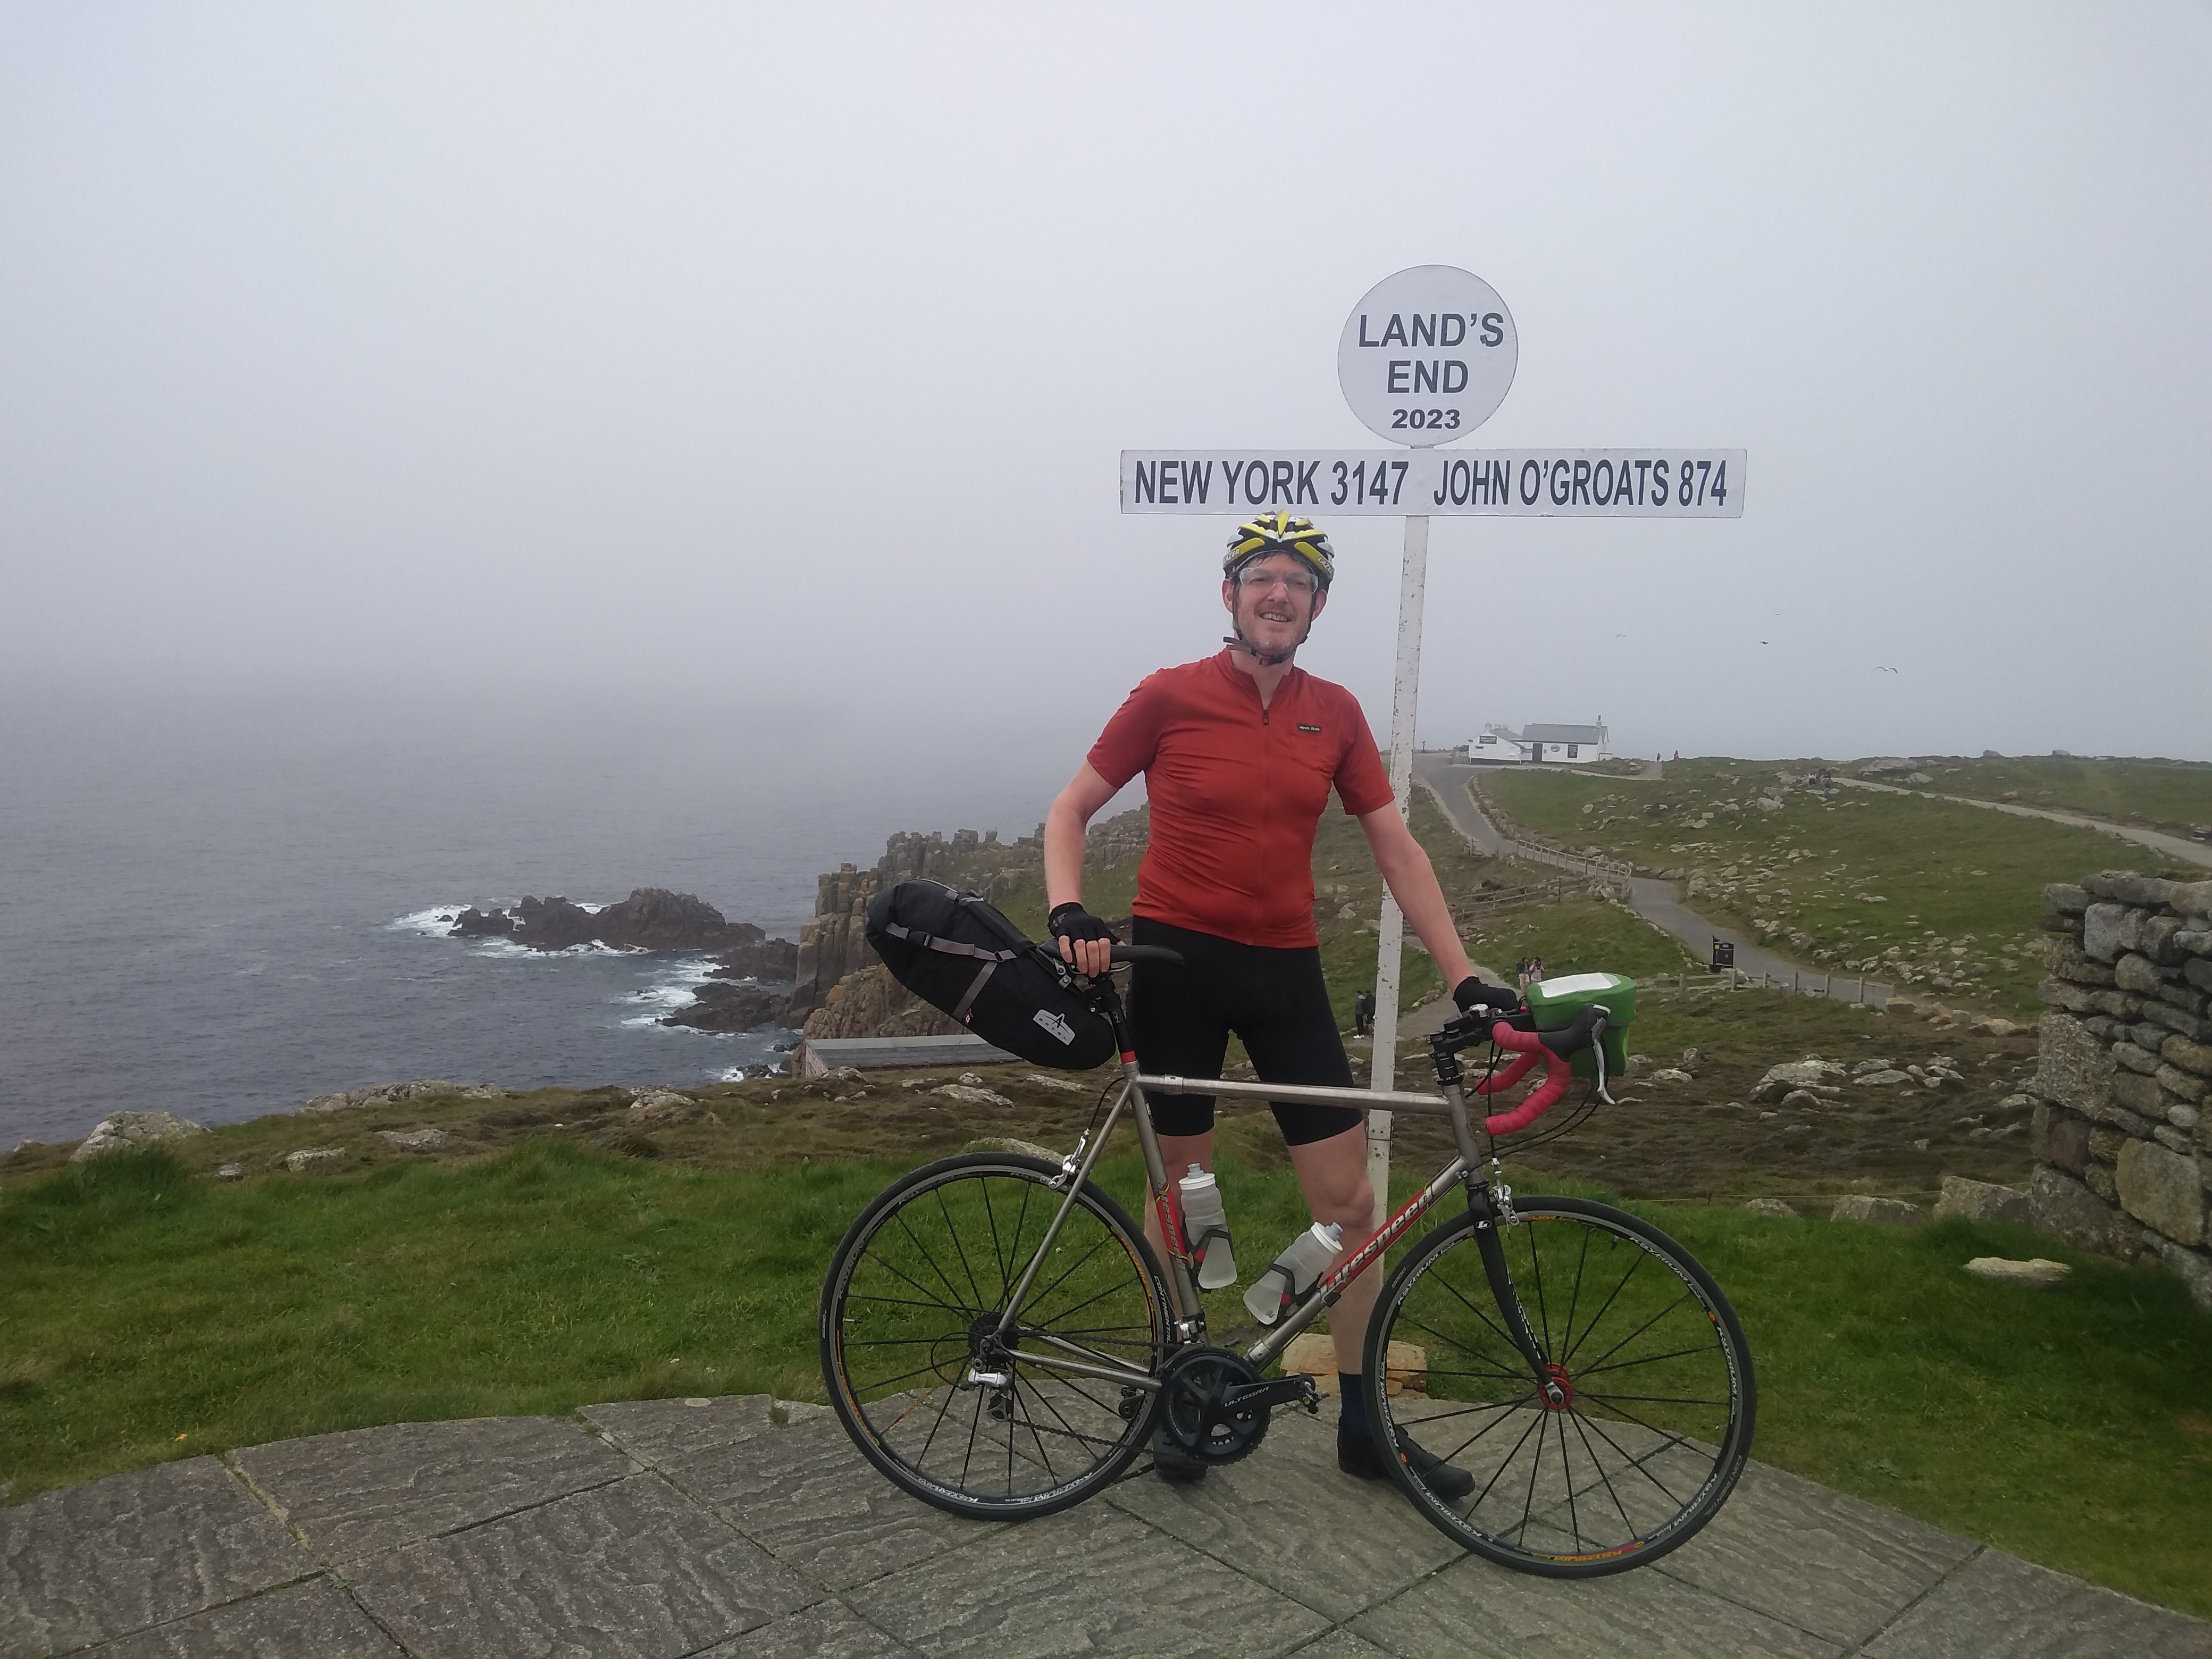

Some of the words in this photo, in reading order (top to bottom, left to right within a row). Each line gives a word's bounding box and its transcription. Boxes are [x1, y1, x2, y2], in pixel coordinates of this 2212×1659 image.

[1359, 313, 1504, 347] LAND'S
[1387, 360, 1469, 393] END
[1391, 409, 1461, 429] 2023
[1135, 460, 1213, 504] NEW
[1221, 460, 1321, 505] YORK
[1330, 460, 1409, 506] 3147
[1434, 459, 1511, 506] JOHN
[1520, 459, 1669, 507] O'GROATS
[1679, 460, 1727, 507] 874
[1154, 1275, 1171, 1339] CONTINENTAL
[1224, 1386, 1270, 1407] ULTEGRA
[1704, 1455, 1743, 1516] CONTINENTAL
